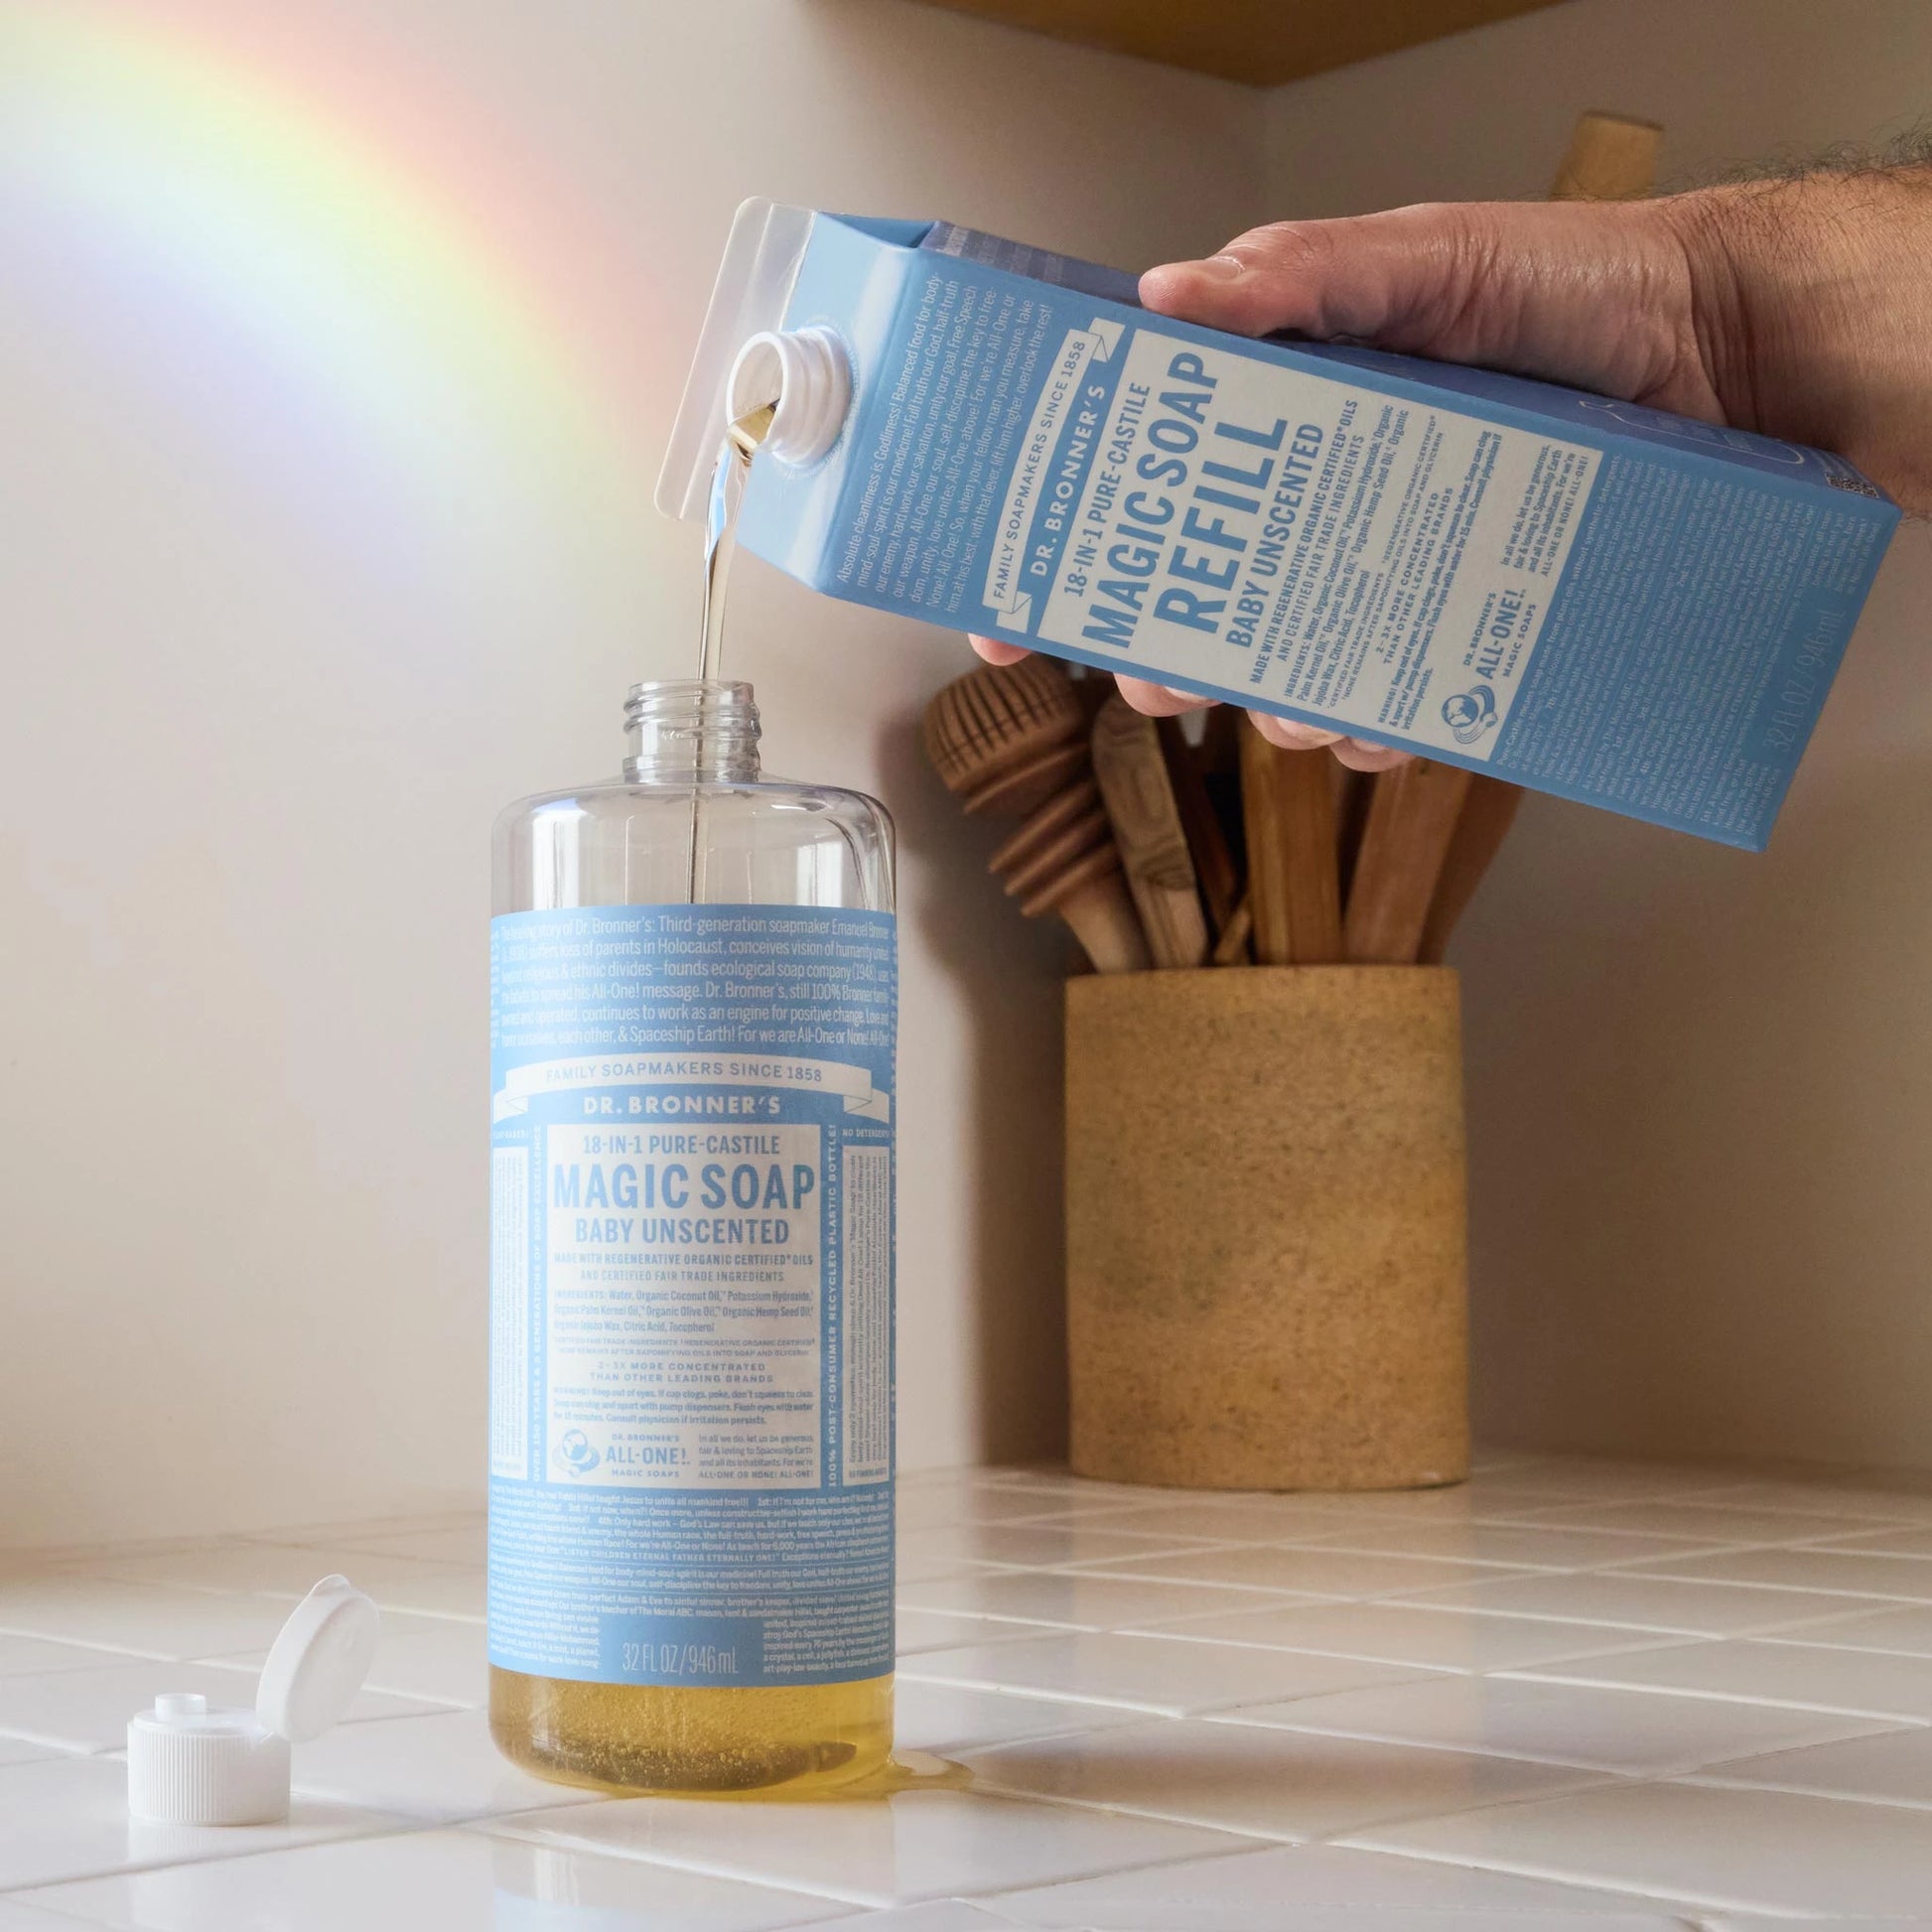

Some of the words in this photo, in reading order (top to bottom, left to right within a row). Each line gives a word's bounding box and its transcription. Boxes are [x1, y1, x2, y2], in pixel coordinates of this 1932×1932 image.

[920, 272, 944, 304] body-
[978, 286, 998, 313] free-
[1003, 294, 1014, 306] or
[914, 306, 929, 321] for
[974, 315, 988, 326] to
[987, 309, 1011, 350] All-One
[906, 322, 925, 347] food
[967, 329, 986, 347] key
[891, 349, 917, 401] Balanced
[961, 349, 977, 367] the
[979, 351, 997, 381] we're
[939, 369, 971, 444] self-discipline
[969, 383, 986, 401] For
[874, 402, 900, 460] Godliness!
[960, 402, 979, 440] above!
[870, 462, 884, 472] is
[944, 443, 968, 483] All-One
[994, 542, 1016, 599] FAMILY
[1007, 434, 1043, 540] SOAPMAKERS
[1040, 380, 1067, 431] SINCE
[1060, 341, 1085, 378] 1858
[1030, 538, 1056, 575] DR.
[1044, 385, 1104, 530] BRONNER'S
[925, 474, 937, 491] our
[1063, 528, 1102, 597] 18-IN-1
[1087, 382, 1150, 523] PURE-CASTILE
[1081, 491, 1173, 647] MAGIC
[1136, 352, 1217, 486] SOAP
[853, 474, 880, 533] cleanliness
[909, 493, 932, 532] All-One
[937, 483, 955, 517] unites
[1350, 518, 1371, 552] Organic
[1363, 490, 1381, 516] Hemp
[1373, 467, 1389, 488] Seed
[1541, 540, 1559, 575] ALL-ONE
[1554, 526, 1564, 537] OR
[1559, 497, 1573, 523] NONE!
[1569, 456, 1587, 495] ALL-ONE!
[926, 519, 944, 542] love
[1153, 418, 1287, 633] REFILL
[1225, 581, 1269, 647] BABY
[1250, 424, 1322, 576] UNSCENTED
[1250, 654, 1269, 682] MADE
[1261, 626, 1279, 652] WITH
[1271, 544, 1308, 624] REGENERATIVE
[1300, 492, 1325, 542] ORGANIC
[1339, 400, 1357, 426] OILS
[836, 534, 861, 582] Absolute
[1277, 638, 1293, 660] AND
[1285, 581, 1313, 635] CERTIFIED
[1306, 553, 1323, 578] FAIR
[1315, 515, 1336, 549] TRADE
[1329, 435, 1363, 512] INGREDIENTS
[1387, 590, 1404, 621] MORE
[1400, 492, 1438, 585] CONCENTRATED
[1323, 548, 1343, 582] Coconut
[1383, 634, 1400, 662] THAN
[1396, 593, 1415, 630] OTHER
[1412, 539, 1435, 589] LEADING
[1431, 487, 1452, 534] BRANDS
[893, 580, 904, 597] our
[1311, 583, 1331, 615] Organic
[1321, 600, 1342, 632] Organic
[1334, 576, 1350, 598] Olive
[1344, 570, 1369, 615] Tocopherol
[1303, 617, 1320, 639] Water,
[1337, 618, 1353, 637] Acid,
[1462, 651, 1474, 665] DR.
[1469, 593, 1495, 647] BRONNER'S
[1475, 590, 1523, 679] ALL-ONE!
[1502, 642, 1521, 676] MAGIC
[1517, 604, 1535, 637] SOAPS
[1328, 637, 1345, 660] Citric
[1285, 645, 1310, 696] INGREDIENTS:
[1297, 681, 1312, 701] Palm
[1305, 653, 1322, 679] Kernel
[1321, 662, 1337, 679] Wax,
[1312, 681, 1329, 705] Jojoba
[575, 917, 589, 934] Dr.
[769, 918, 830, 936] soapmaker
[596, 940, 640, 958] parents
[643, 938, 655, 955] in
[730, 939, 790, 955] conceives
[791, 940, 823, 956] vision
[825, 940, 835, 956] of
[593, 983, 639, 999] All-One!
[705, 982, 723, 998] Dr.
[789, 983, 810, 999] still
[812, 983, 841, 1000] 100%
[582, 1005, 640, 1021] continues
[643, 1005, 655, 1020] to
[657, 1004, 690, 1020] work
[692, 1007, 707, 1020] as
[708, 1007, 725, 1020] an
[727, 1005, 768, 1024] engine
[771, 1005, 787, 1020] for
[790, 1006, 832, 1026] positive
[619, 1026, 627, 1041] &
[629, 1025, 695, 1045] Spaceship
[697, 1026, 735, 1041] Earth!
[738, 1026, 758, 1041] For
[759, 1030, 776, 1041] we
[777, 1030, 797, 1042] are
[797, 1027, 835, 1043] All-One
[836, 1032, 845, 1044] or
[546, 1065, 597, 1082] FAMILY
[602, 1061, 724, 1077] SOAPMAKERS
[730, 1062, 783, 1078] SINCE
[787, 1065, 822, 1082] 1858
[584, 1095, 622, 1114] DR.
[628, 1095, 780, 1114] BRONNER'S
[584, 1135, 642, 1154] 18-IN-1
[649, 1135, 780, 1154] PURE-CASTILE
[828, 1124, 837, 1181] BOTTLE!
[553, 1164, 689, 1209] MAGIC
[700, 1164, 815, 1209] SOAP
[576, 1218, 633, 1244] BABY
[642, 1218, 789, 1244] UNSCENTED
[828, 1187, 837, 1245] PLASTIC
[605, 1253, 681, 1265] REGENERATIVE
[684, 1254, 732, 1265] ORGANIC
[793, 1254, 813, 1265] OILS
[654, 1271, 678, 1282] FAIR
[682, 1271, 713, 1282] TRADE
[717, 1271, 784, 1282] INGREDIENTS
[828, 1250, 837, 1320] RECYCLED
[668, 1362, 765, 1371] CONCENTRATED
[828, 1325, 837, 1444] POST-CONSUMER
[606, 1446, 687, 1465] ALL-ONE!
[828, 1449, 837, 1486] 100%
[621, 1642, 639, 1671] 32
[642, 1643, 657, 1673] FL
